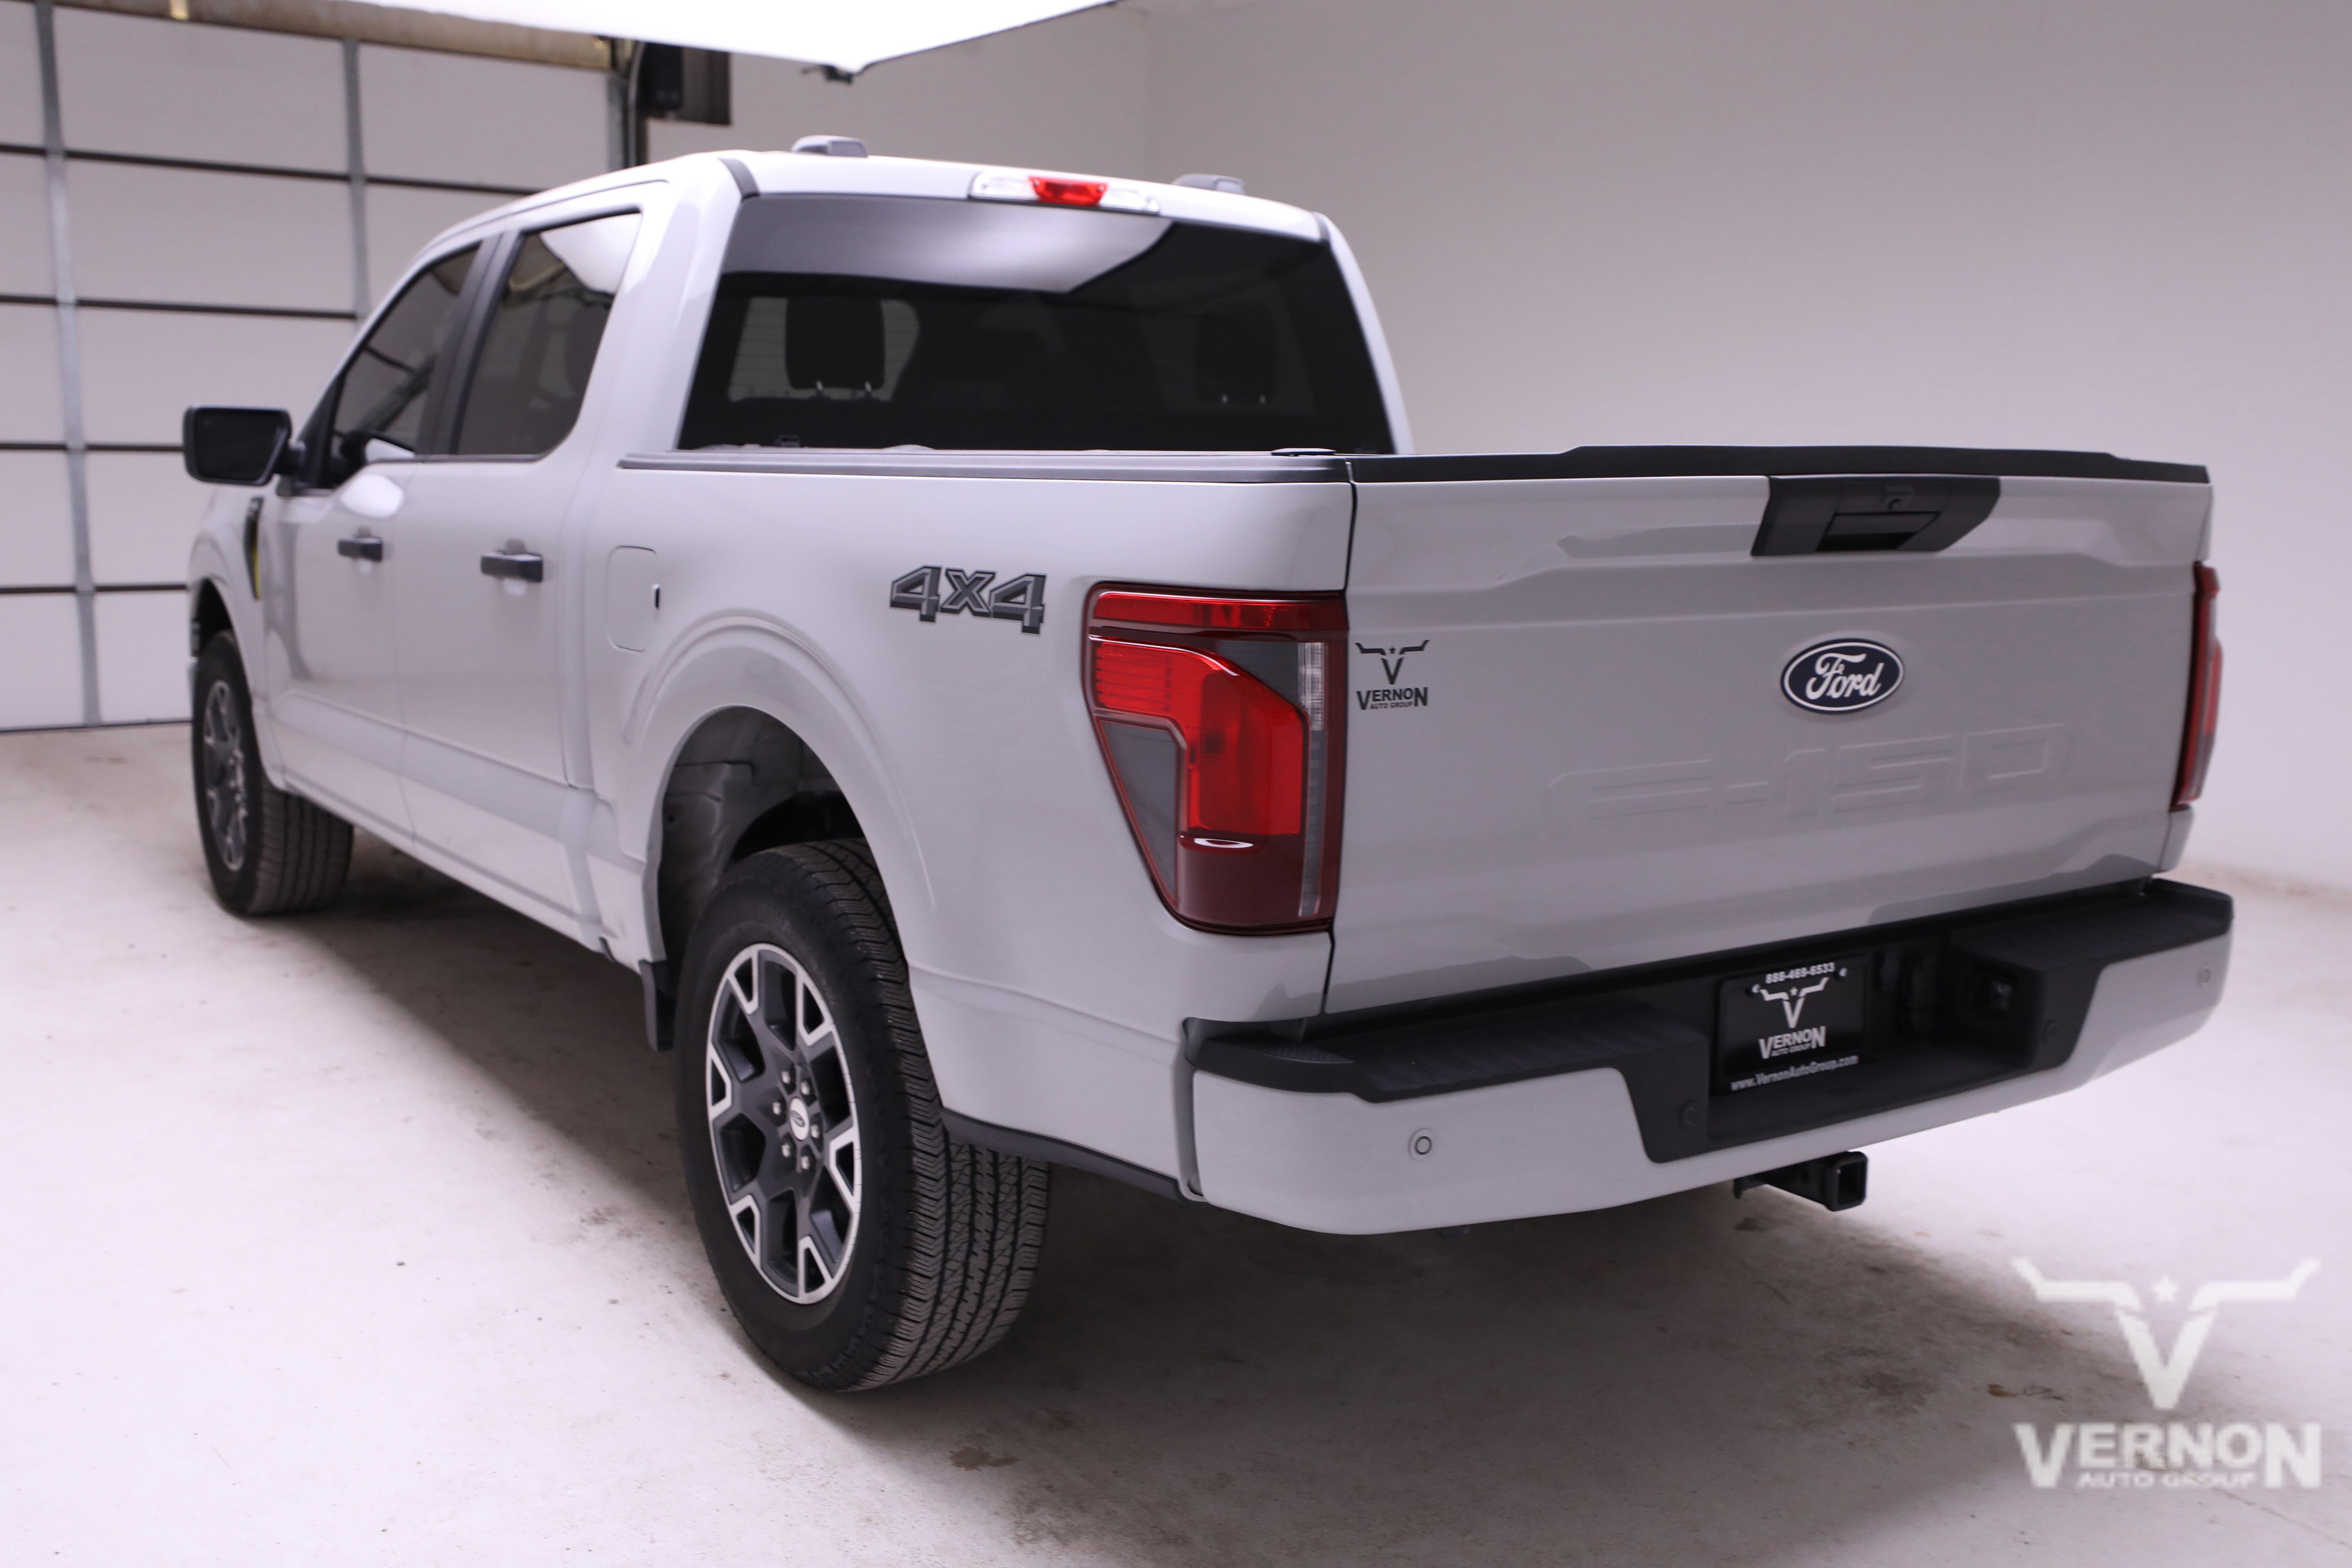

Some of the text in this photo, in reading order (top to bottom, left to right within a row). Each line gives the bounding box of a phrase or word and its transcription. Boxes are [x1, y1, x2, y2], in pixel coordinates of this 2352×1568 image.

[1806, 653, 1884, 700] Ford
[1356, 687, 1428, 710] VERNON
[1759, 1026, 1826, 1059] VERNON
